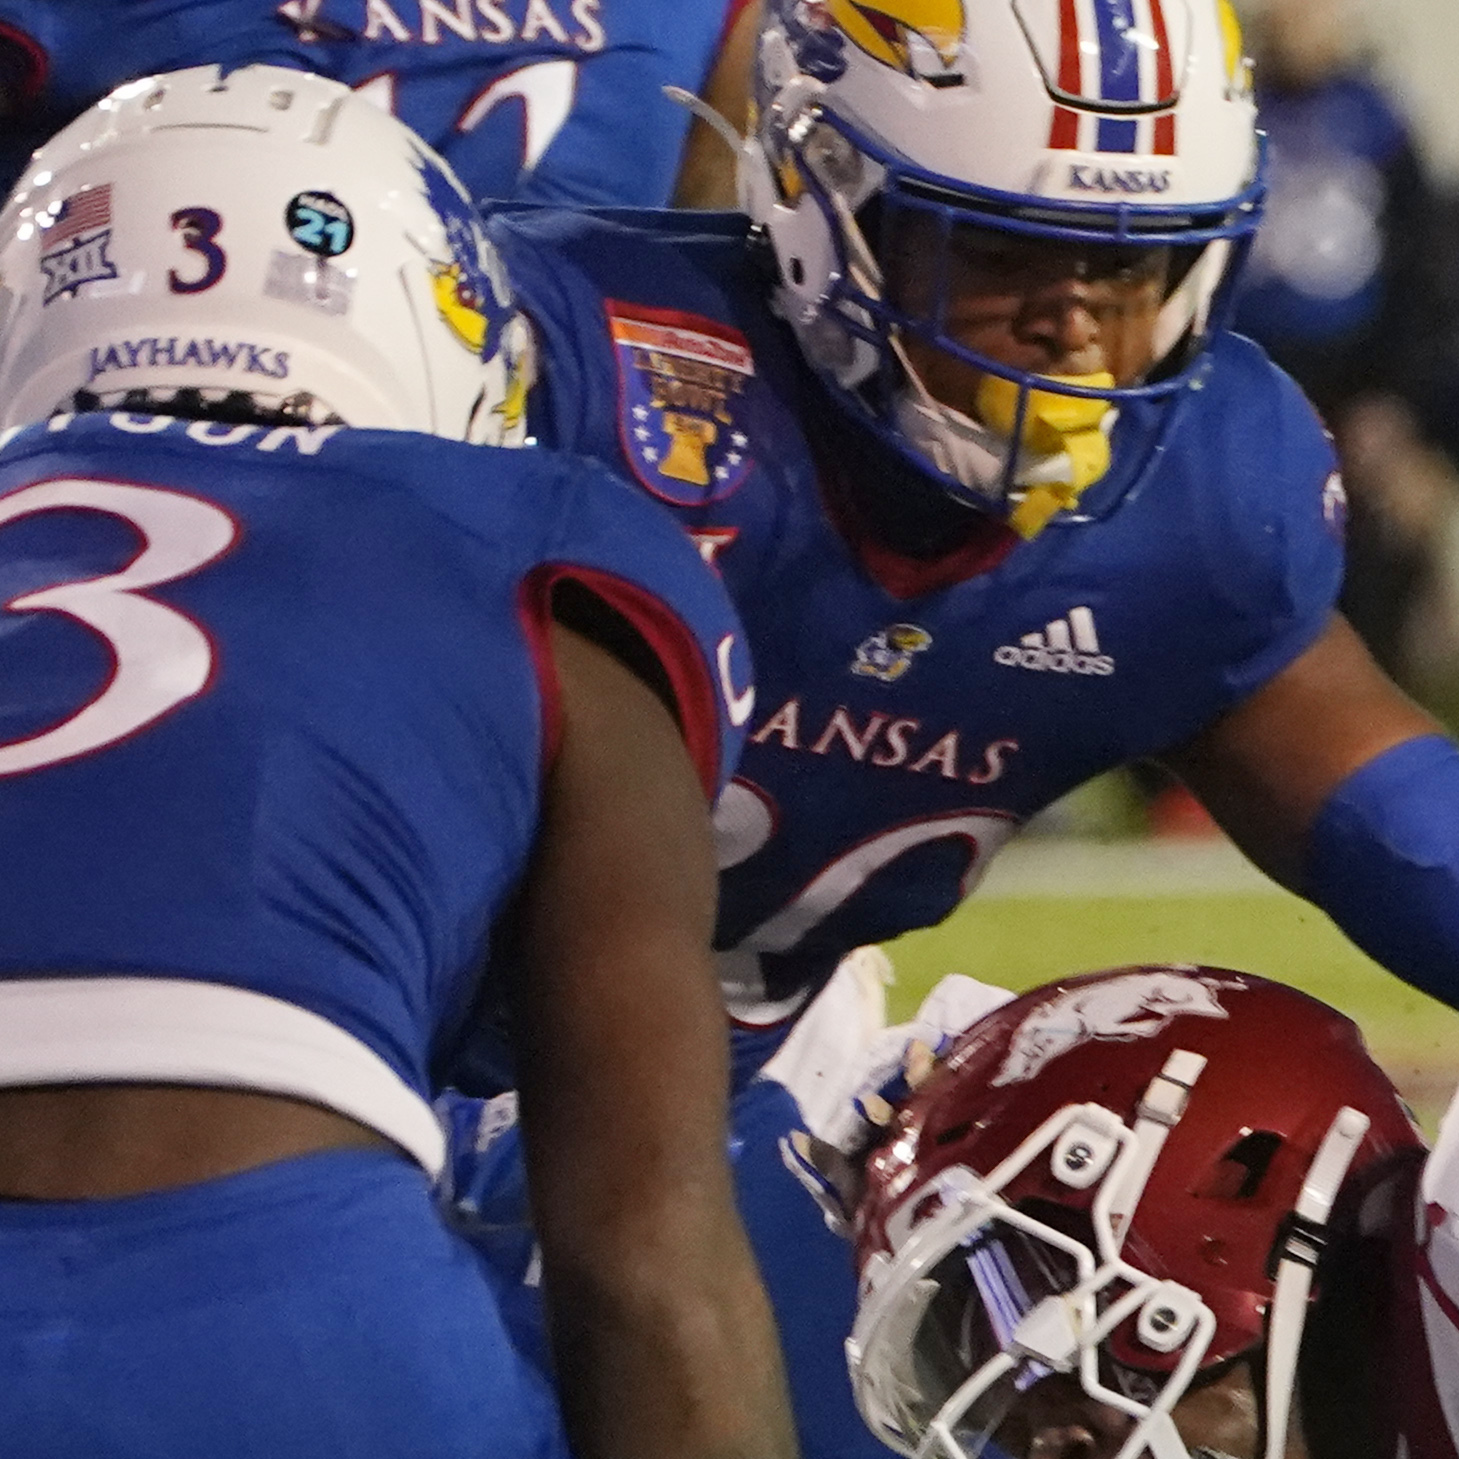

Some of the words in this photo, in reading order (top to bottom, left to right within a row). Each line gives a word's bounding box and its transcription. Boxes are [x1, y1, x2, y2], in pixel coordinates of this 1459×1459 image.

[1067, 164, 1171, 194] KANSAS
[167, 206, 228, 295] 3
[295, 207, 351, 254] 21
[87, 336, 291, 384] JAYHAWKS
[0, 476, 245, 778] 3
[993, 644, 1115, 676] adidas
[751, 699, 1021, 786] ANSAS
